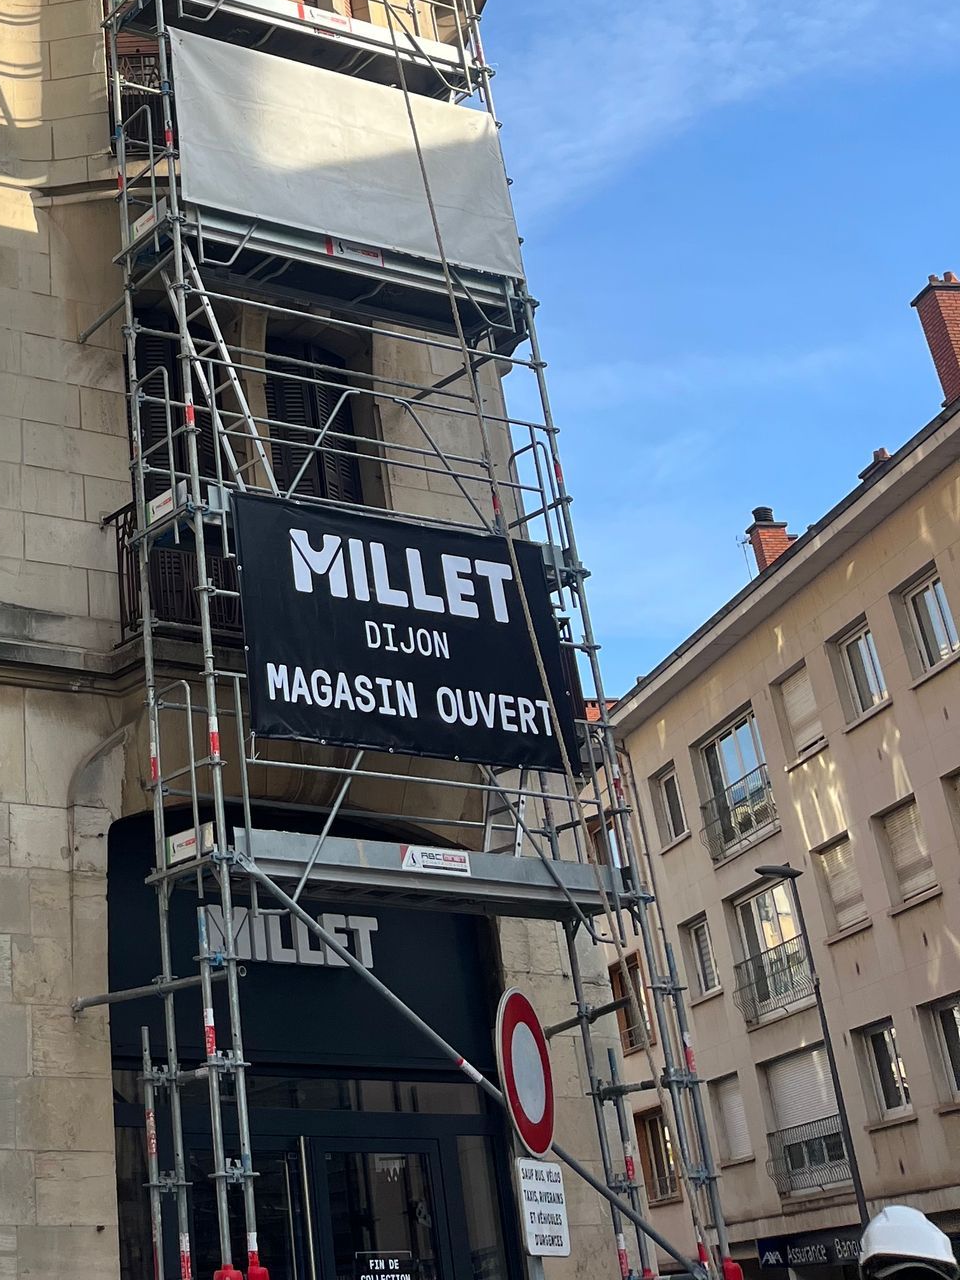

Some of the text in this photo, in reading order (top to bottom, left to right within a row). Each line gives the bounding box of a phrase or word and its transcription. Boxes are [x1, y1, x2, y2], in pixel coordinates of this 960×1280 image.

[290, 528, 513, 623] MILLET
[365, 620, 450, 659] DIJON
[266, 662, 553, 736] MAGASIN OUVERT
[205, 904, 379, 968] MILLET
[521, 1167, 534, 1180] SAUF
[546, 1168, 561, 1183] VÉLOS
[524, 1189, 564, 1205] TAXIS, RIVERAINS
[529, 1210, 563, 1225] ET VÉHICULES
[534, 1233, 564, 1247] D'URGENCES
[369, 1258, 400, 1270] FIN DE
[761, 1250, 784, 1265] AXA
[787, 1245, 827, 1263] Assurance
